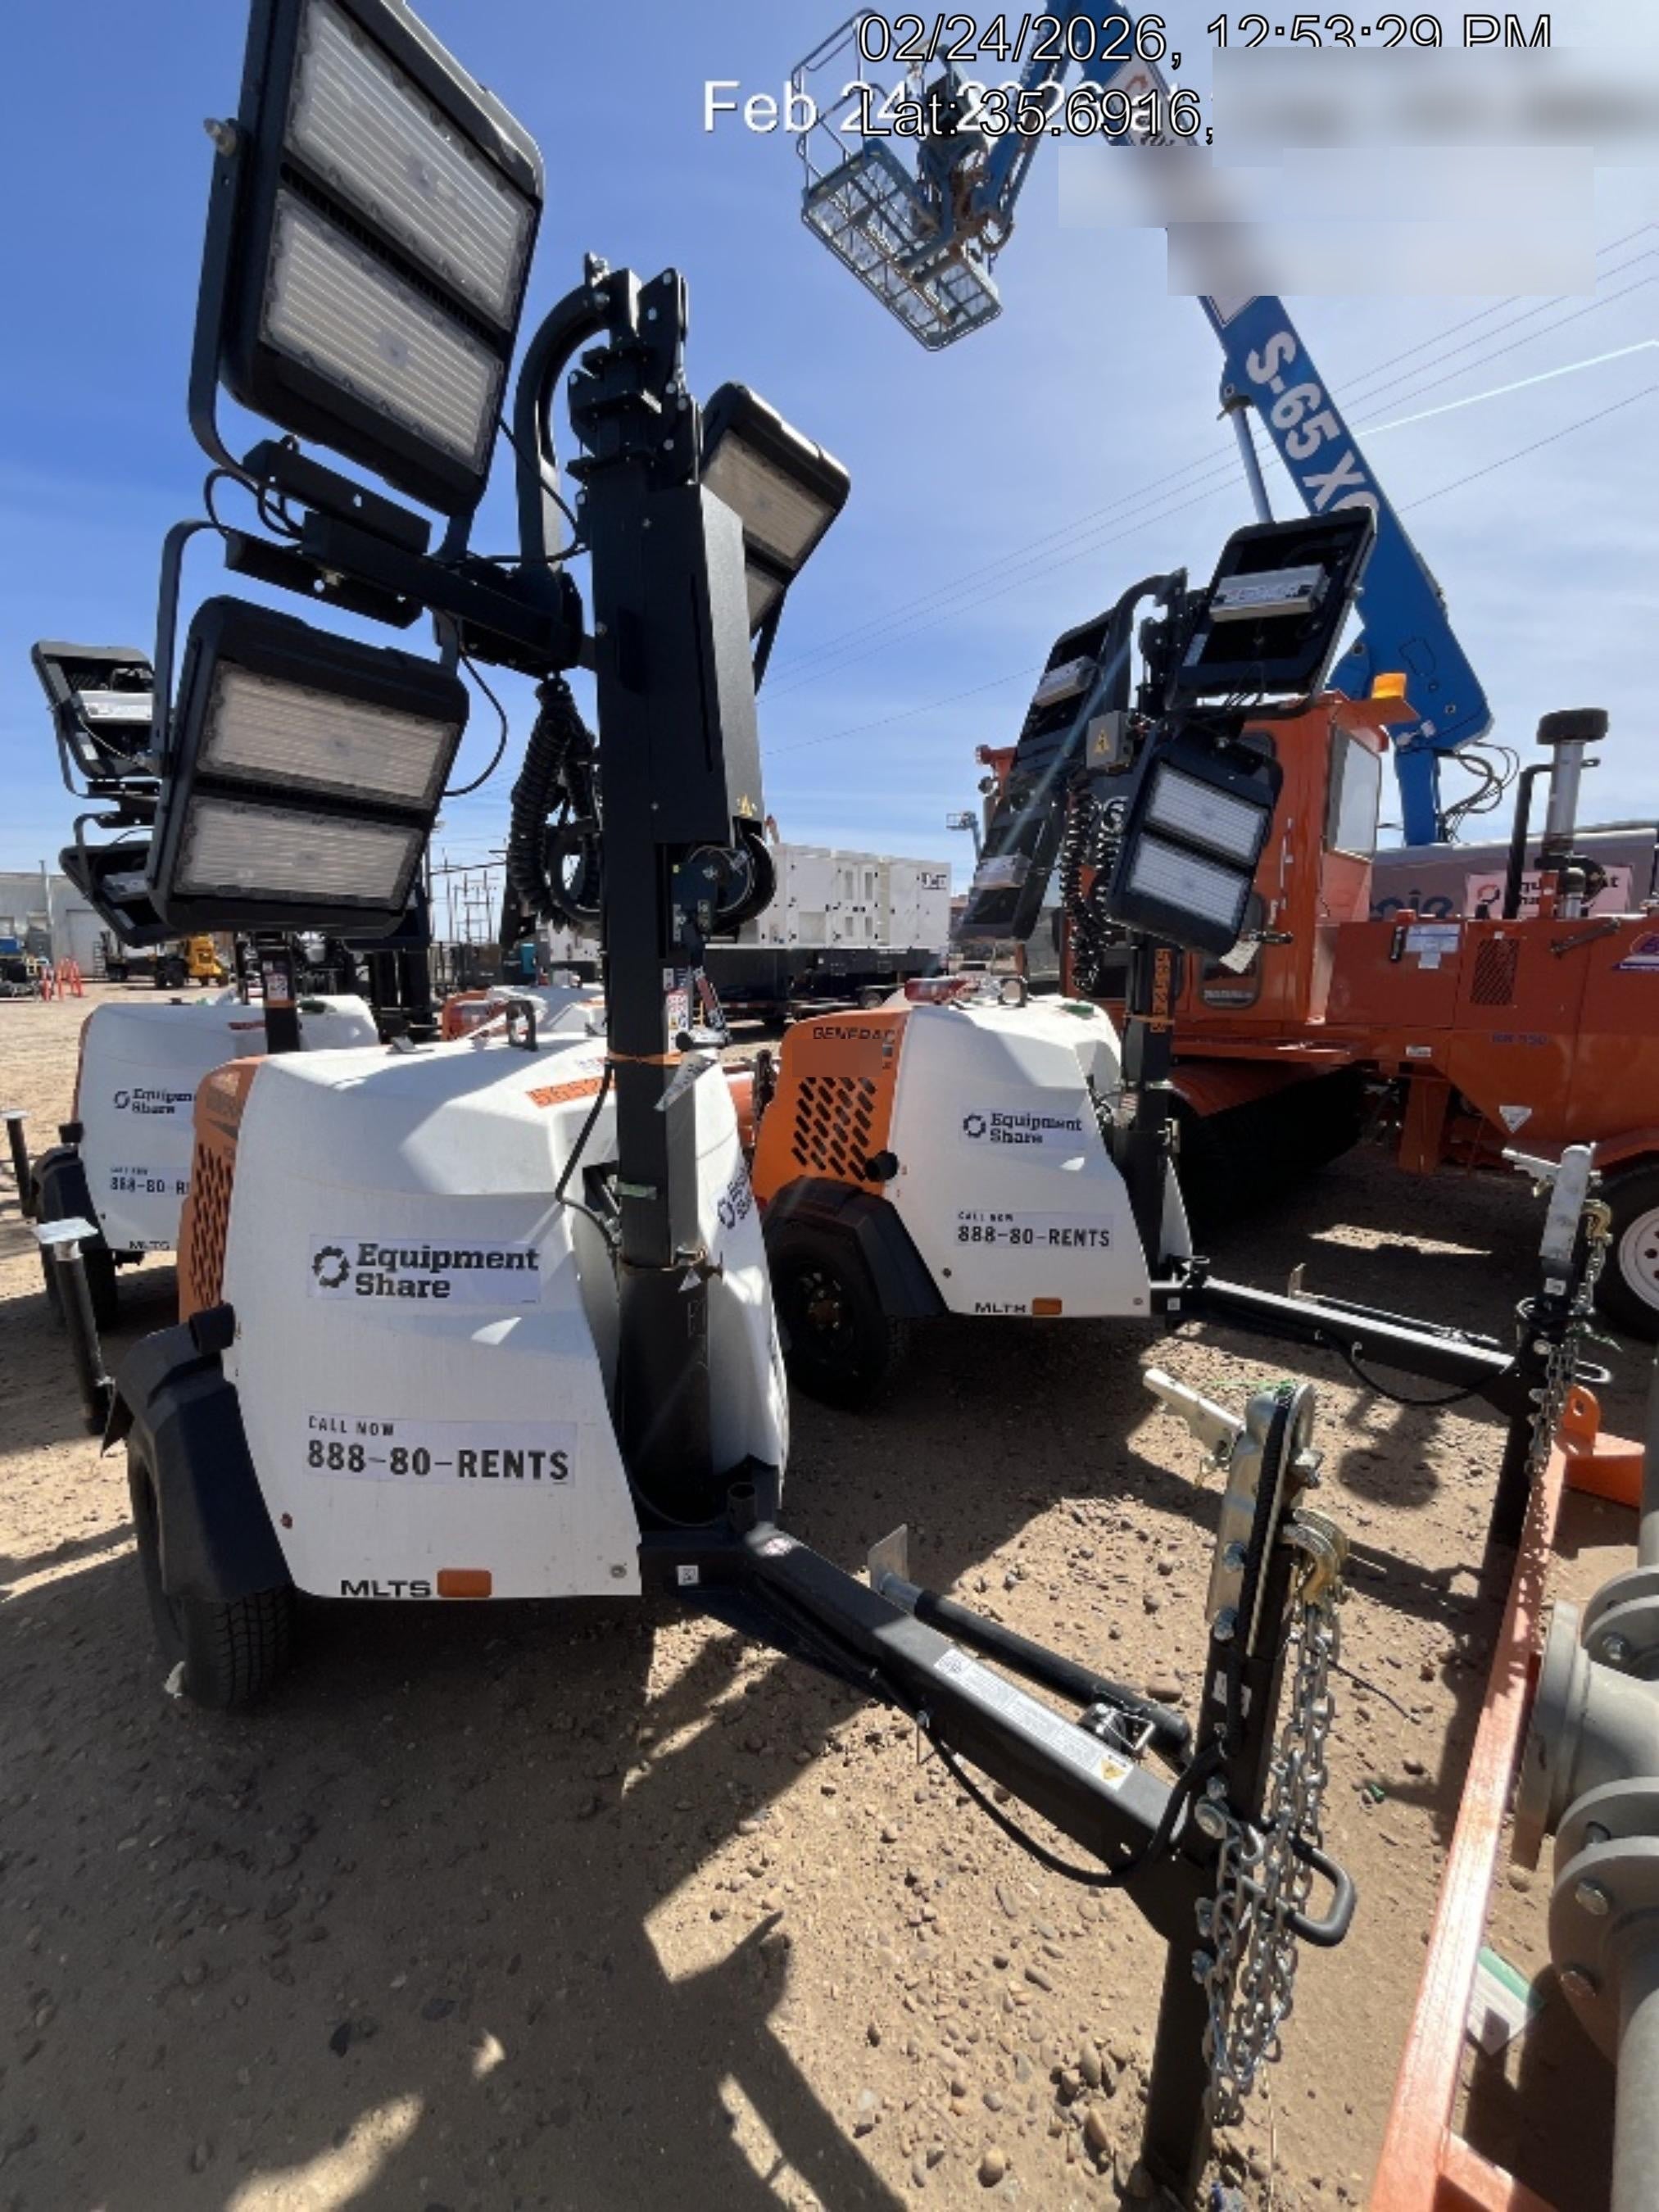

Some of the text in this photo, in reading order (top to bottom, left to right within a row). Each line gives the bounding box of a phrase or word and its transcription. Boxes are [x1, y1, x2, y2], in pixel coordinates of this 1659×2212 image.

[990, 1113, 1081, 1131] Equipment
[356, 1243, 539, 1274] Equipment
[356, 1272, 451, 1298] Share
[308, 1415, 394, 1435] CALL NOW
[307, 1439, 569, 1480] 888-80-RENTS
[340, 1580, 432, 1598] MLTS
